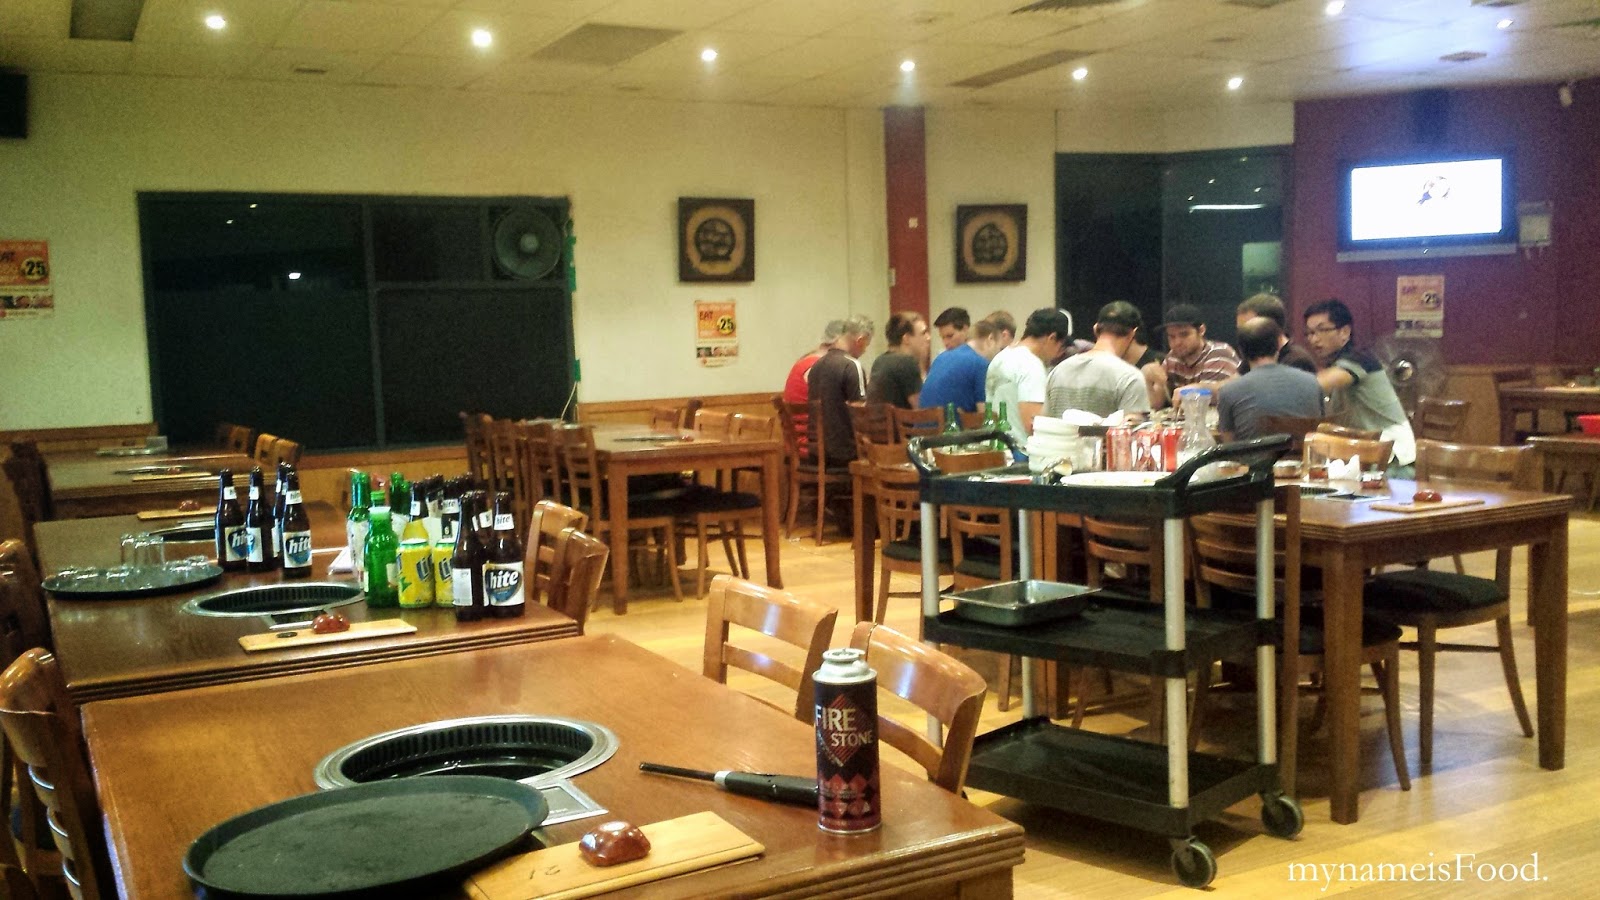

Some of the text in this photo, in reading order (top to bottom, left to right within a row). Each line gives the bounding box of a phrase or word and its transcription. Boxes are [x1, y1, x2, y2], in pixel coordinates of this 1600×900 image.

[699, 311, 713, 320] EAT
[720, 318, 734, 330] 25
[491, 570, 518, 587] hite
[814, 704, 857, 731] FIRE
[831, 730, 874, 747] STONE
